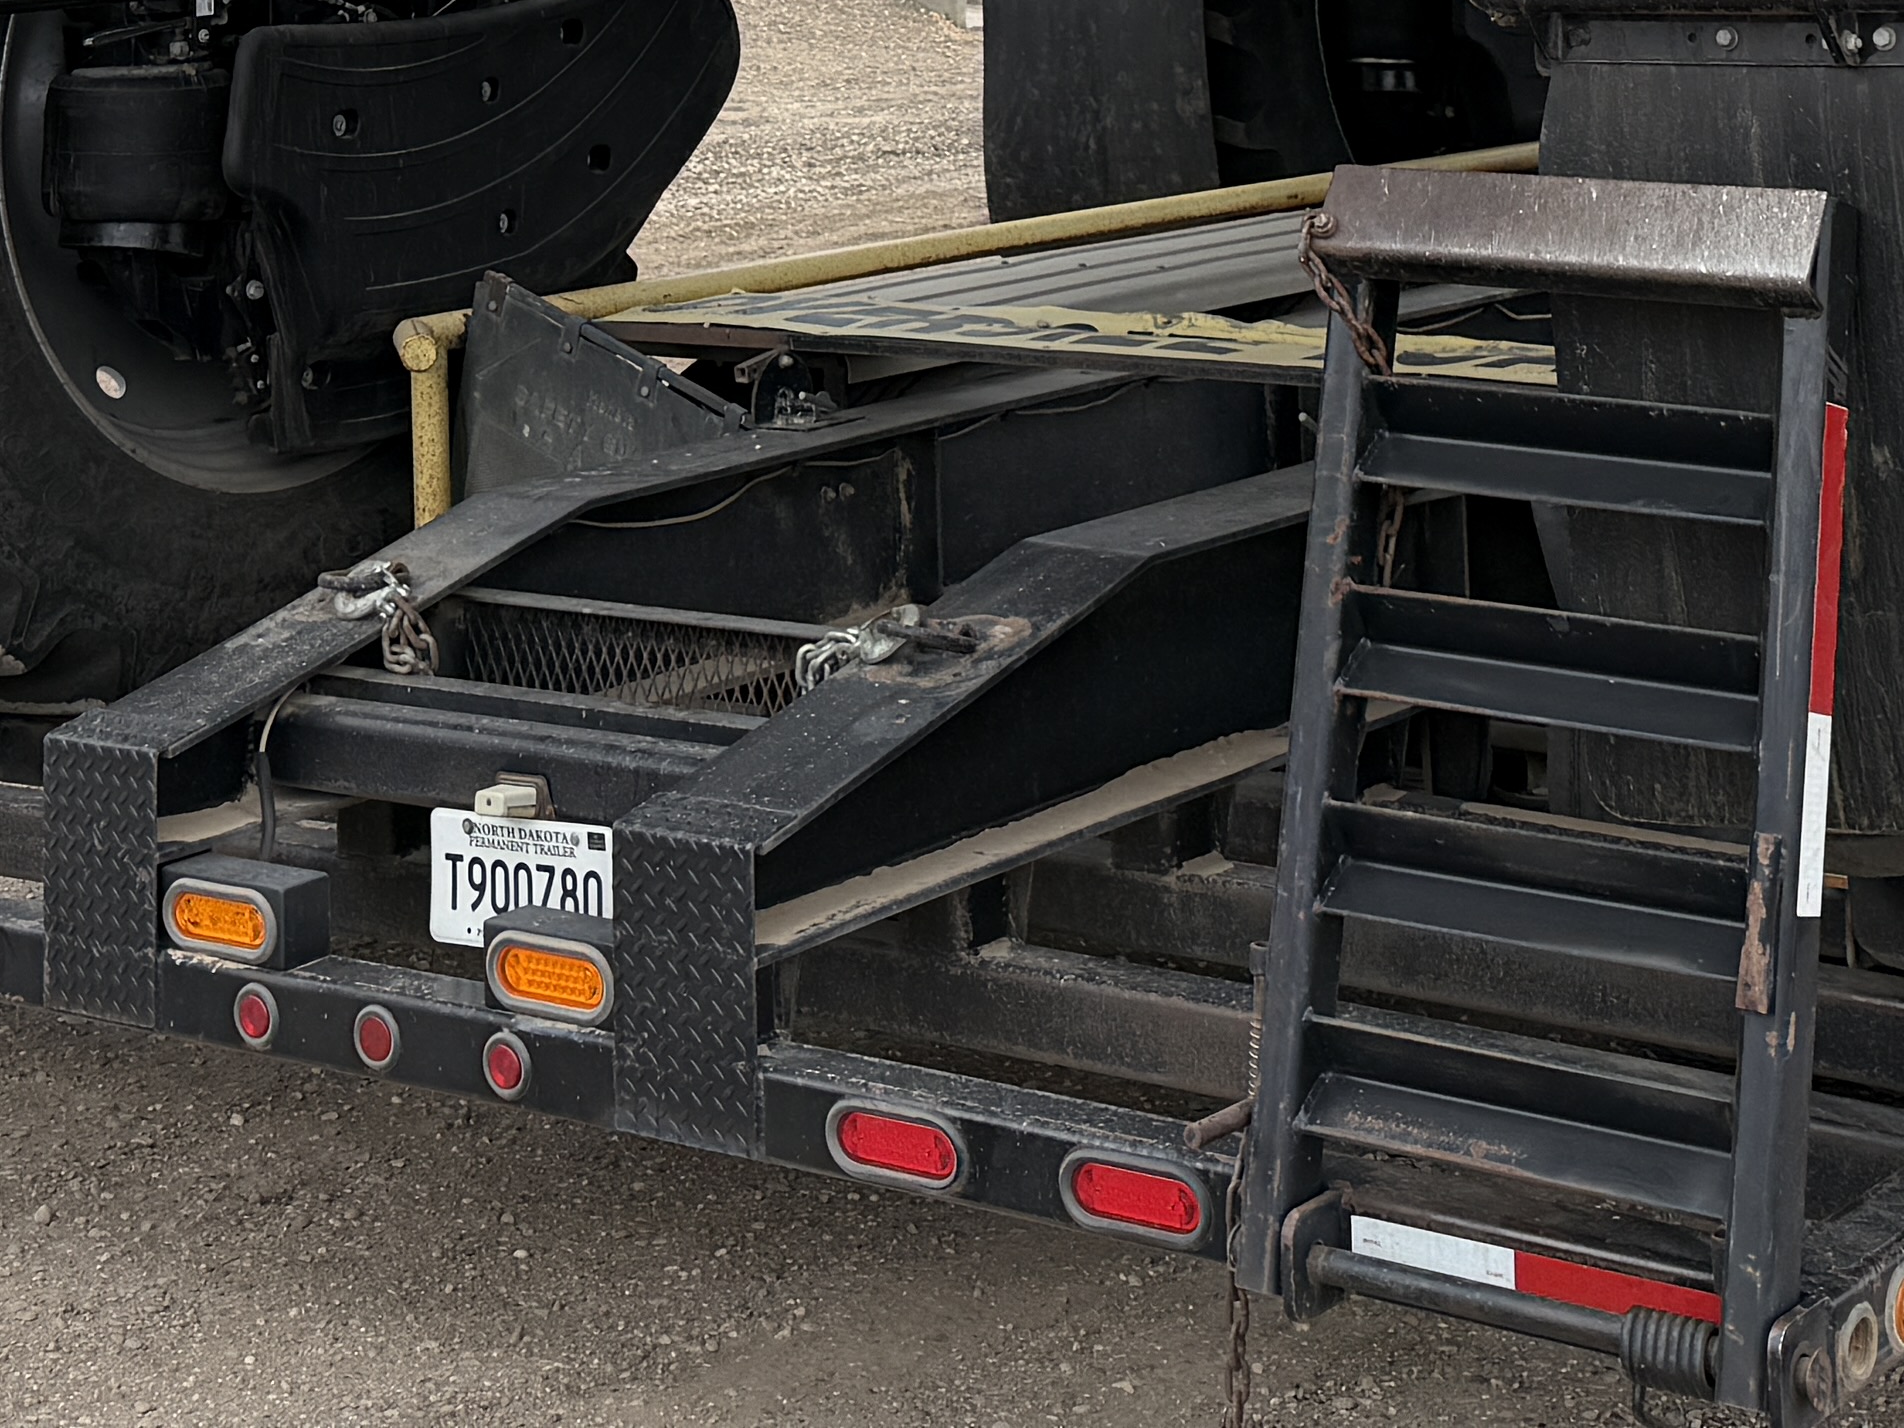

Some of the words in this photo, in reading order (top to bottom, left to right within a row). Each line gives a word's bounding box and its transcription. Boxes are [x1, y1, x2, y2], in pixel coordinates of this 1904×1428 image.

[472, 822, 515, 840] NORTH
[517, 826, 570, 846] DAKOTA
[468, 836, 531, 854] PERMANENT
[534, 842, 577, 858] TRAILER
[445, 852, 603, 920] T900780
